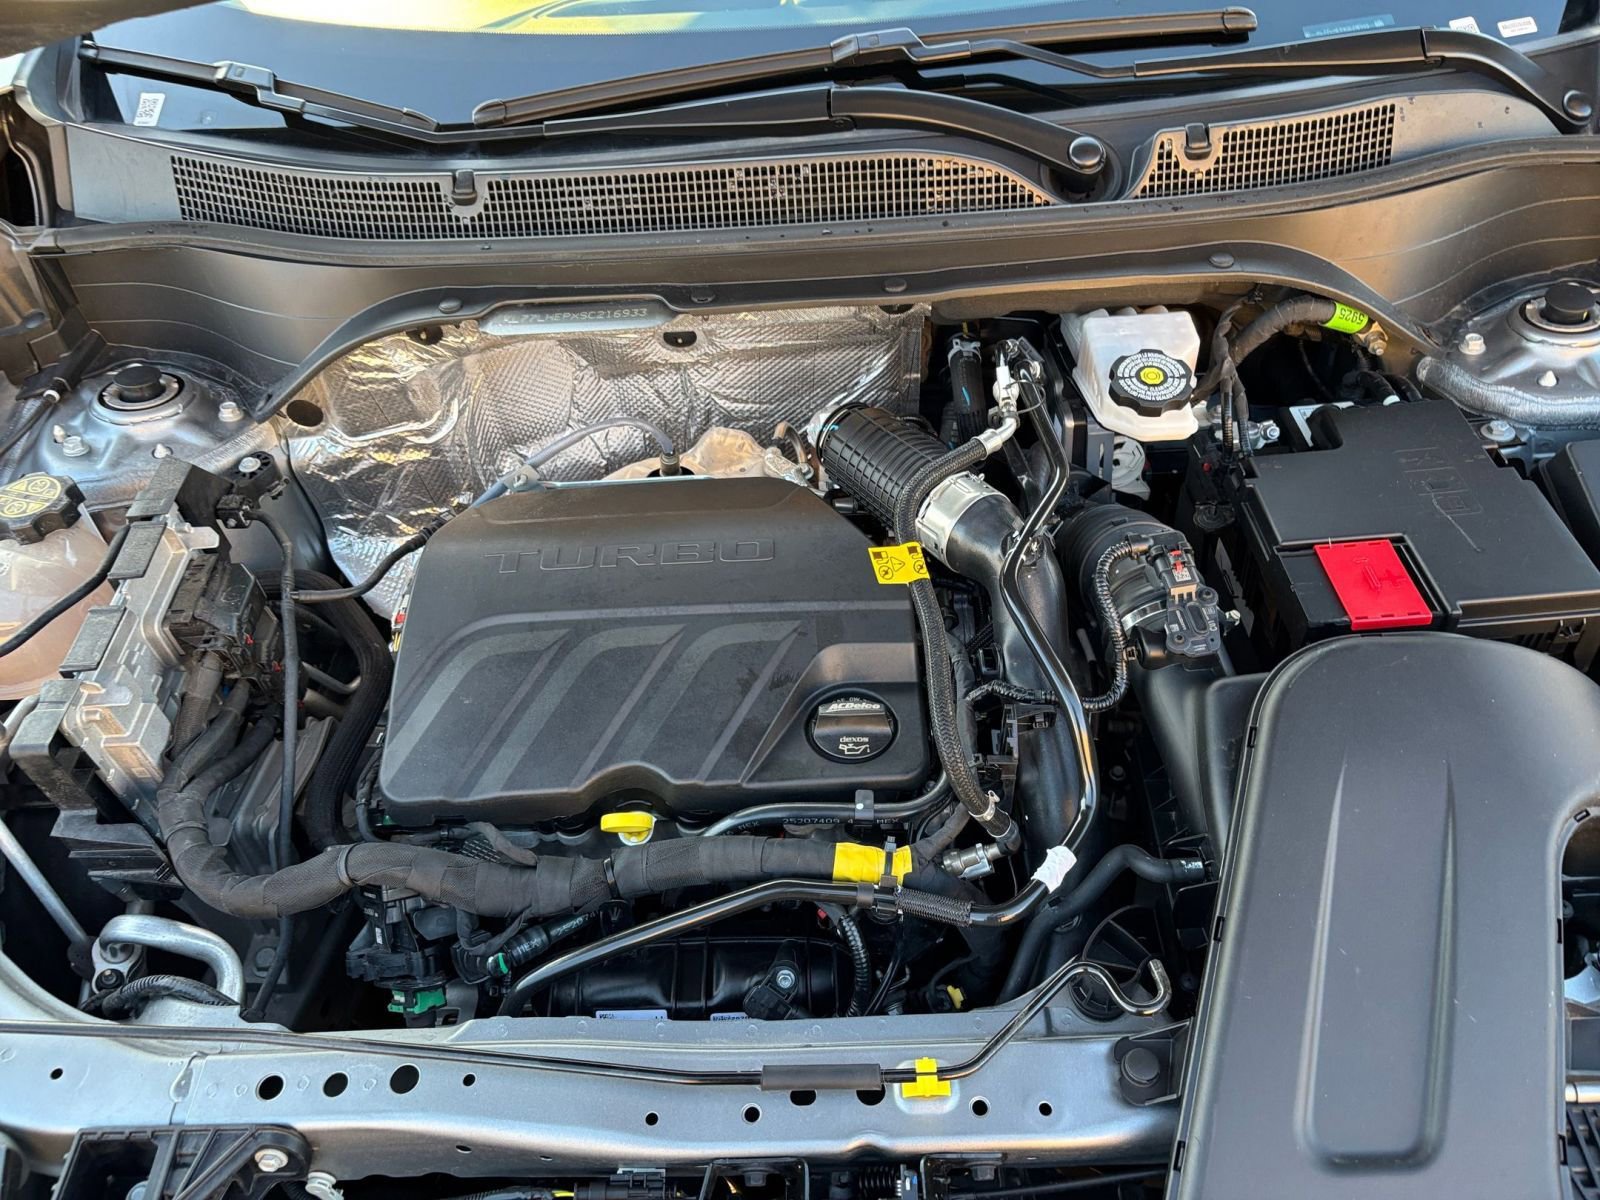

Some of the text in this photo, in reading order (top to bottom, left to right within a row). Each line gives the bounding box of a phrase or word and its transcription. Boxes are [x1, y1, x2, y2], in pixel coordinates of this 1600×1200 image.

[1339, 307, 1365, 324] 5925
[482, 539, 775, 574] TURBO
[826, 702, 880, 712] ACDelco
